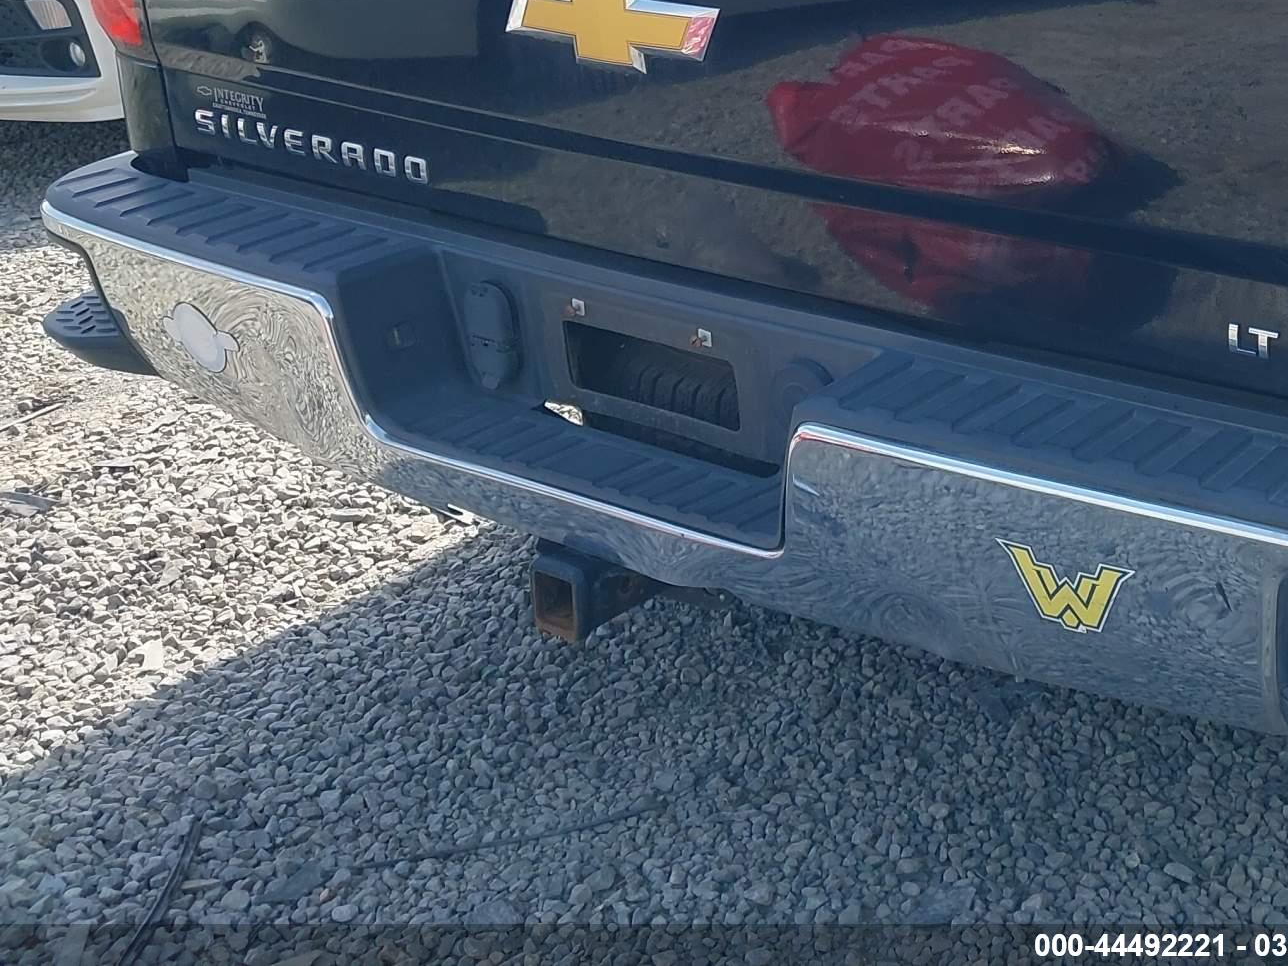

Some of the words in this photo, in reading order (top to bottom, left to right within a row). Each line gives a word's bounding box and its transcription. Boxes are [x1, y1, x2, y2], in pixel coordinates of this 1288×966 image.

[213, 87, 264, 112] INTEGRITY
[194, 109, 429, 184] SILVERADO
[1228, 323, 1279, 360] LT
